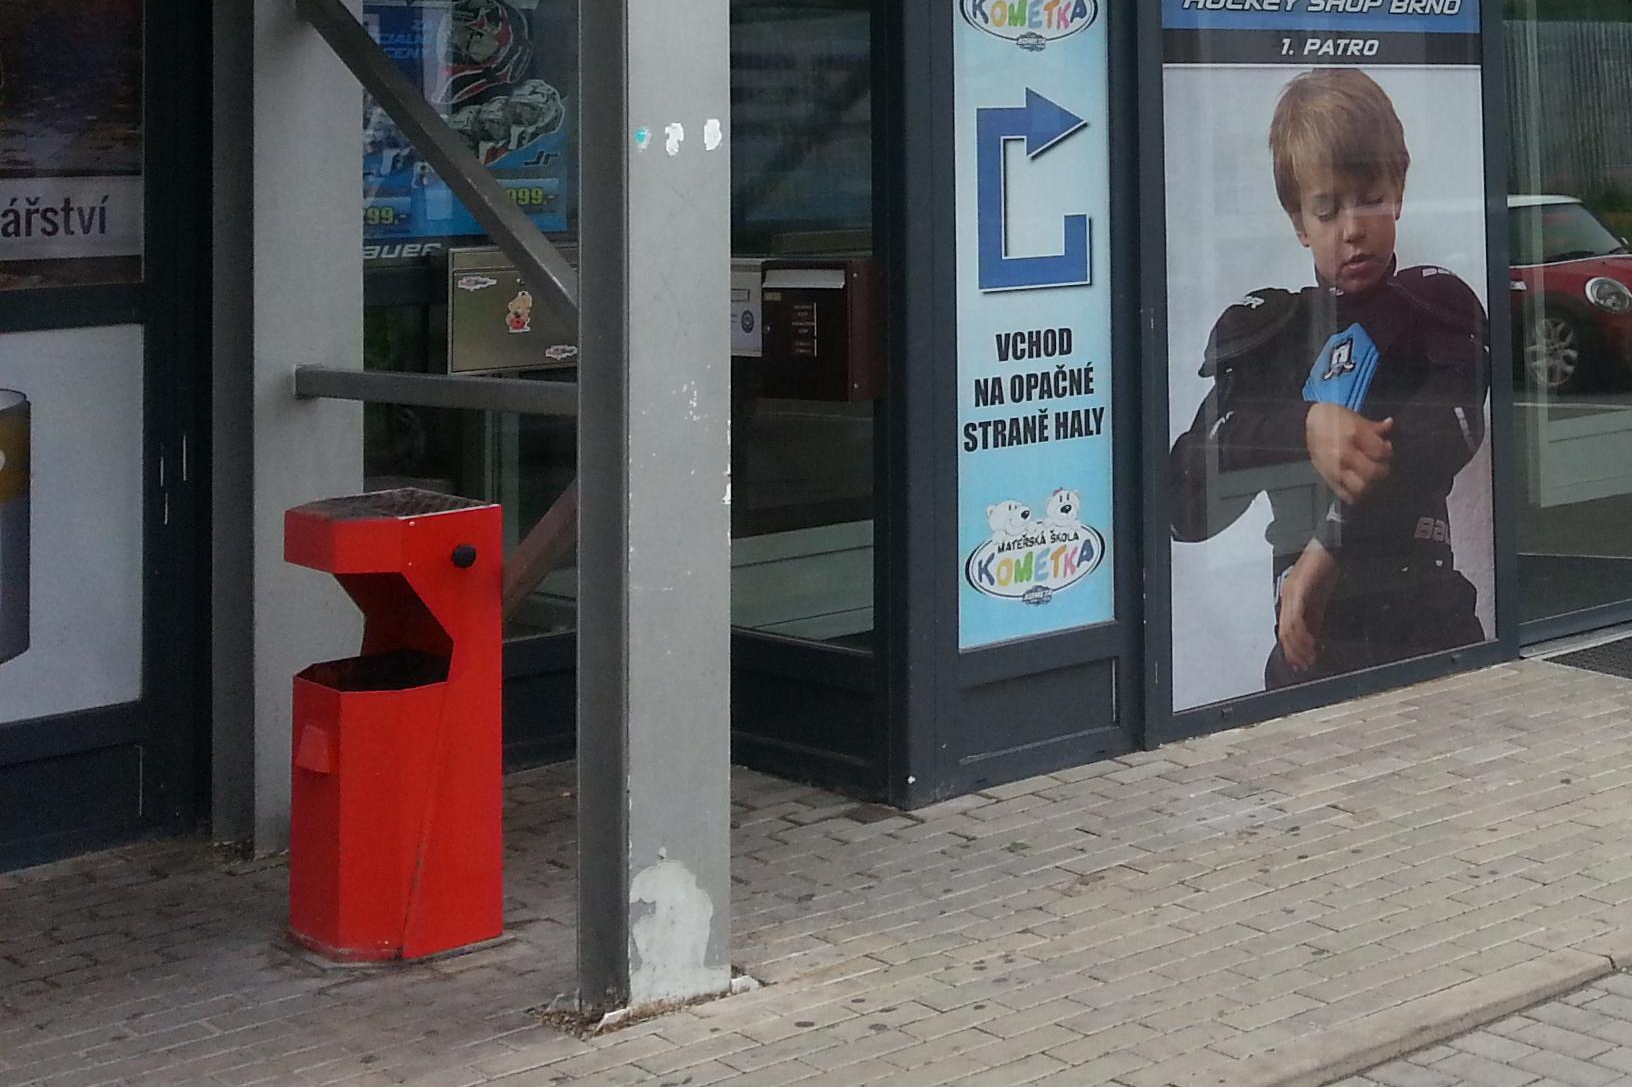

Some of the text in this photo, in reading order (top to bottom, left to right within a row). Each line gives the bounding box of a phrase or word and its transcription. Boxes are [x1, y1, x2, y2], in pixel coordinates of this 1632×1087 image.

[1280, 38, 1380, 56] 1. PATRO
[996, 327, 1073, 362] VCHOD
[974, 361, 1094, 408] NA OPAČNÉ
[963, 407, 1105, 453] STRANĚ HALY
[997, 530, 1080, 554] MATEŘSKÁ ŠKOLA
[977, 539, 1094, 587] KOMETKA
